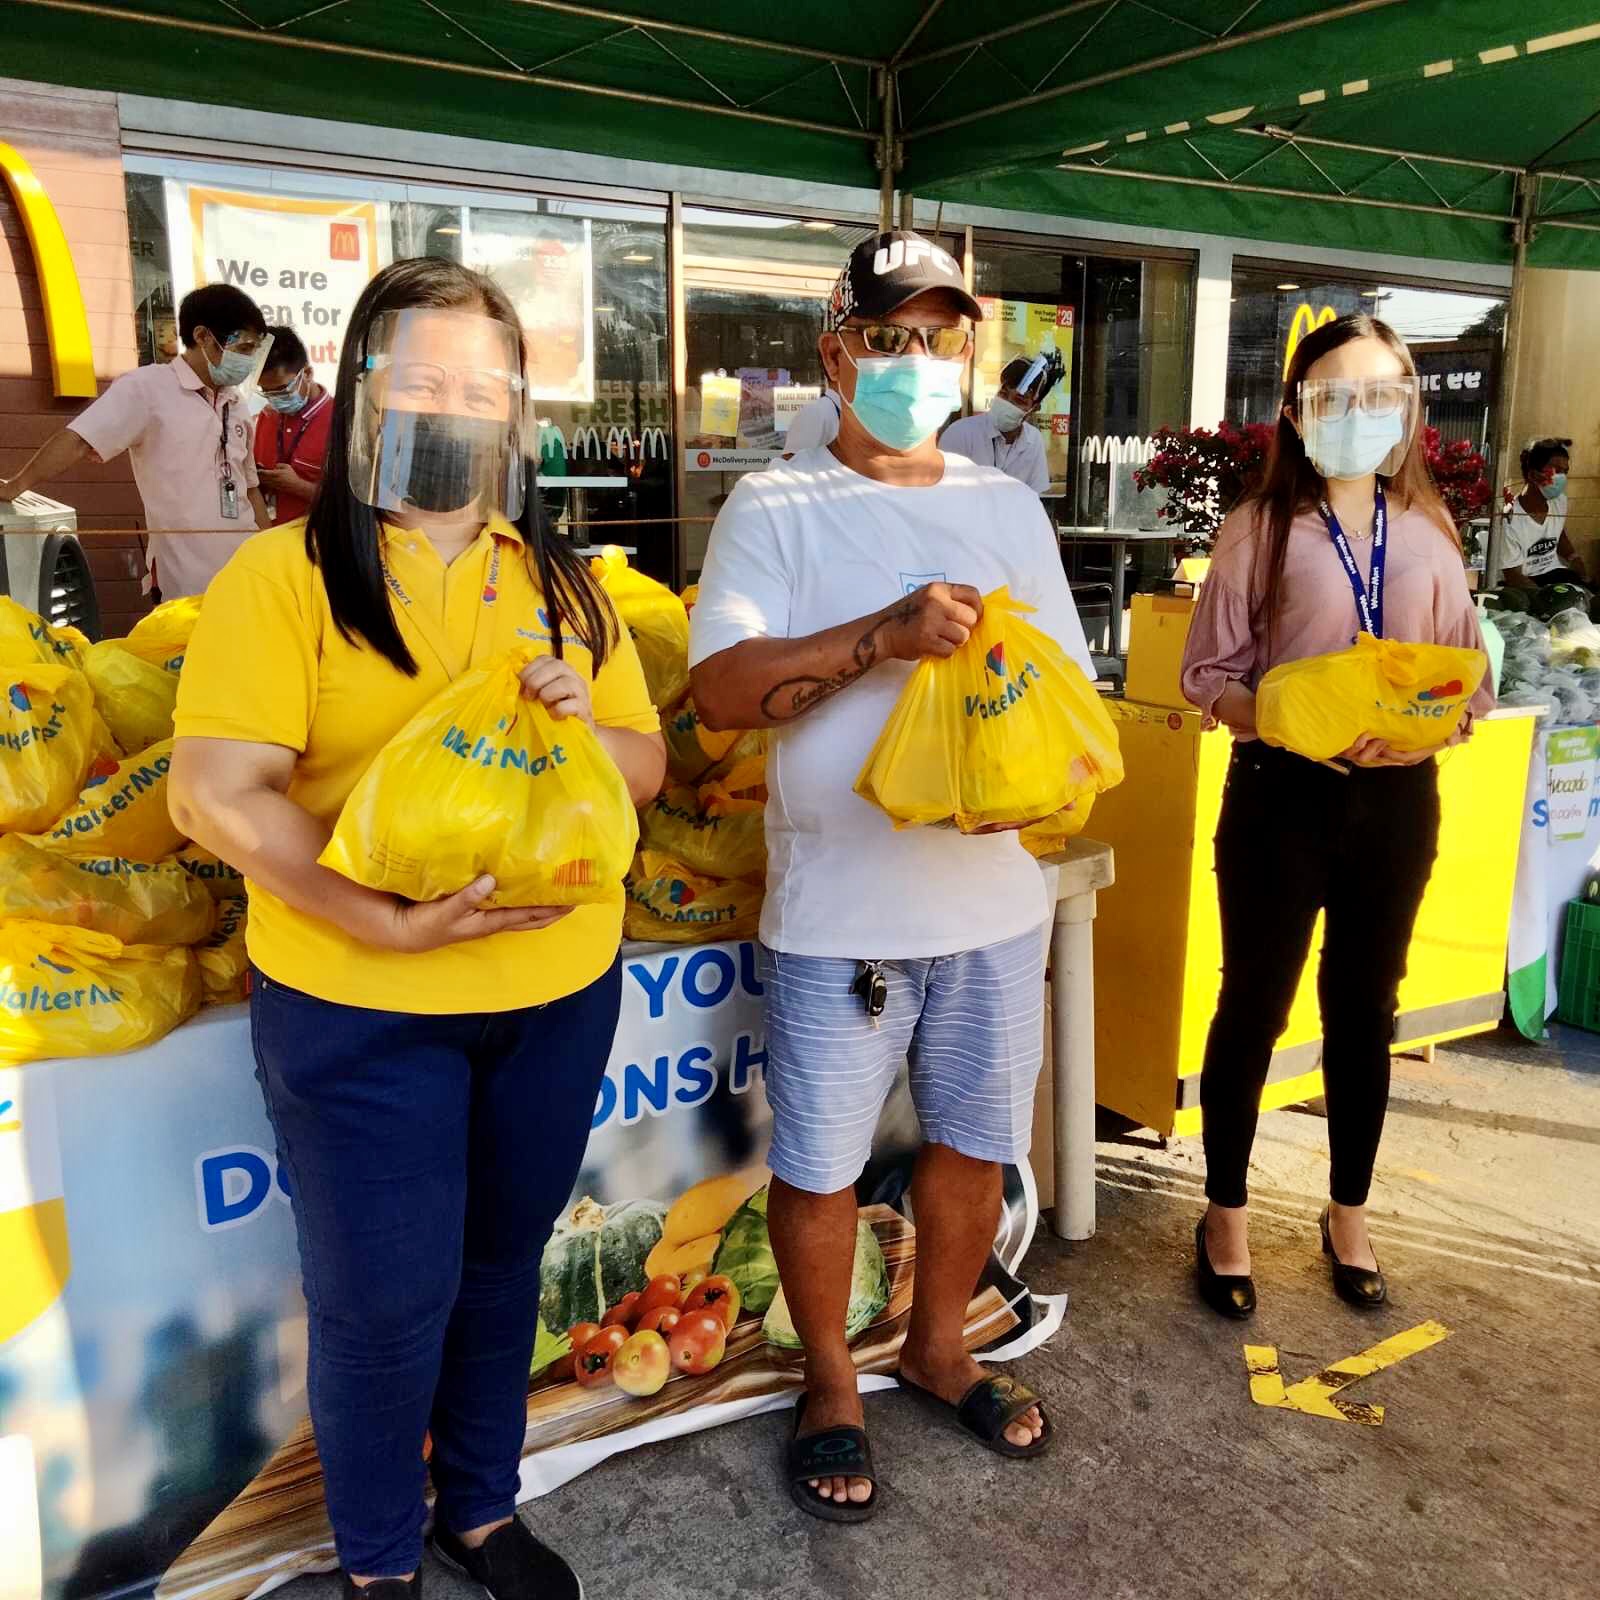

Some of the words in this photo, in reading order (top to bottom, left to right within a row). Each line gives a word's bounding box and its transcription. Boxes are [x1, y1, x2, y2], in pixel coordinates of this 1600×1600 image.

[216, 258, 269, 287] We
[279, 268, 328, 291] are
[873, 240, 955, 276] UFC
[301, 300, 342, 326] for
